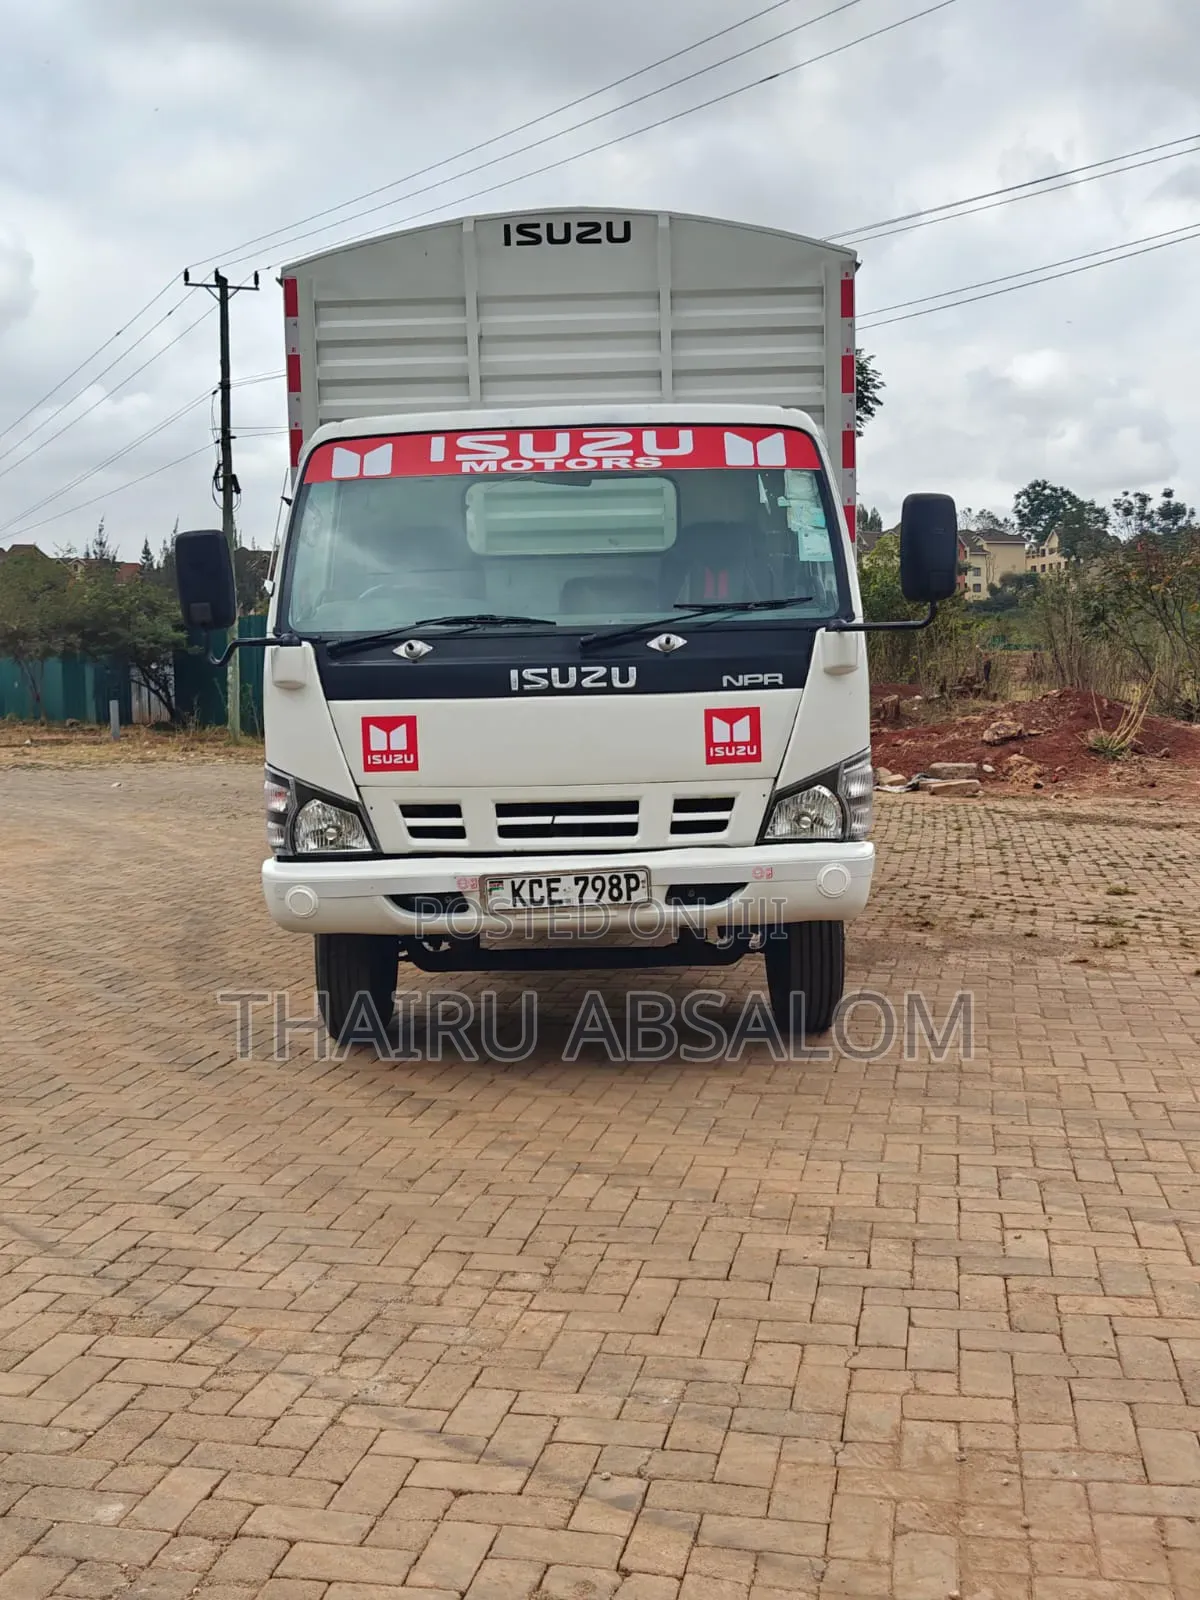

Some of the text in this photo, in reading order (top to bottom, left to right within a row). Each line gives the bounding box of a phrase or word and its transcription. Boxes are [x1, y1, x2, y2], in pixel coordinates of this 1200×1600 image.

[503, 220, 631, 247] ISUZU
[430, 429, 694, 463] ISUZU
[461, 456, 663, 473] MOTORS
[510, 666, 637, 691] ISUZU
[722, 672, 784, 688] NPR
[367, 753, 415, 765] ISUZU
[709, 744, 758, 757] ISUZU
[511, 877, 564, 908] KCE
[574, 873, 641, 905] 798P
